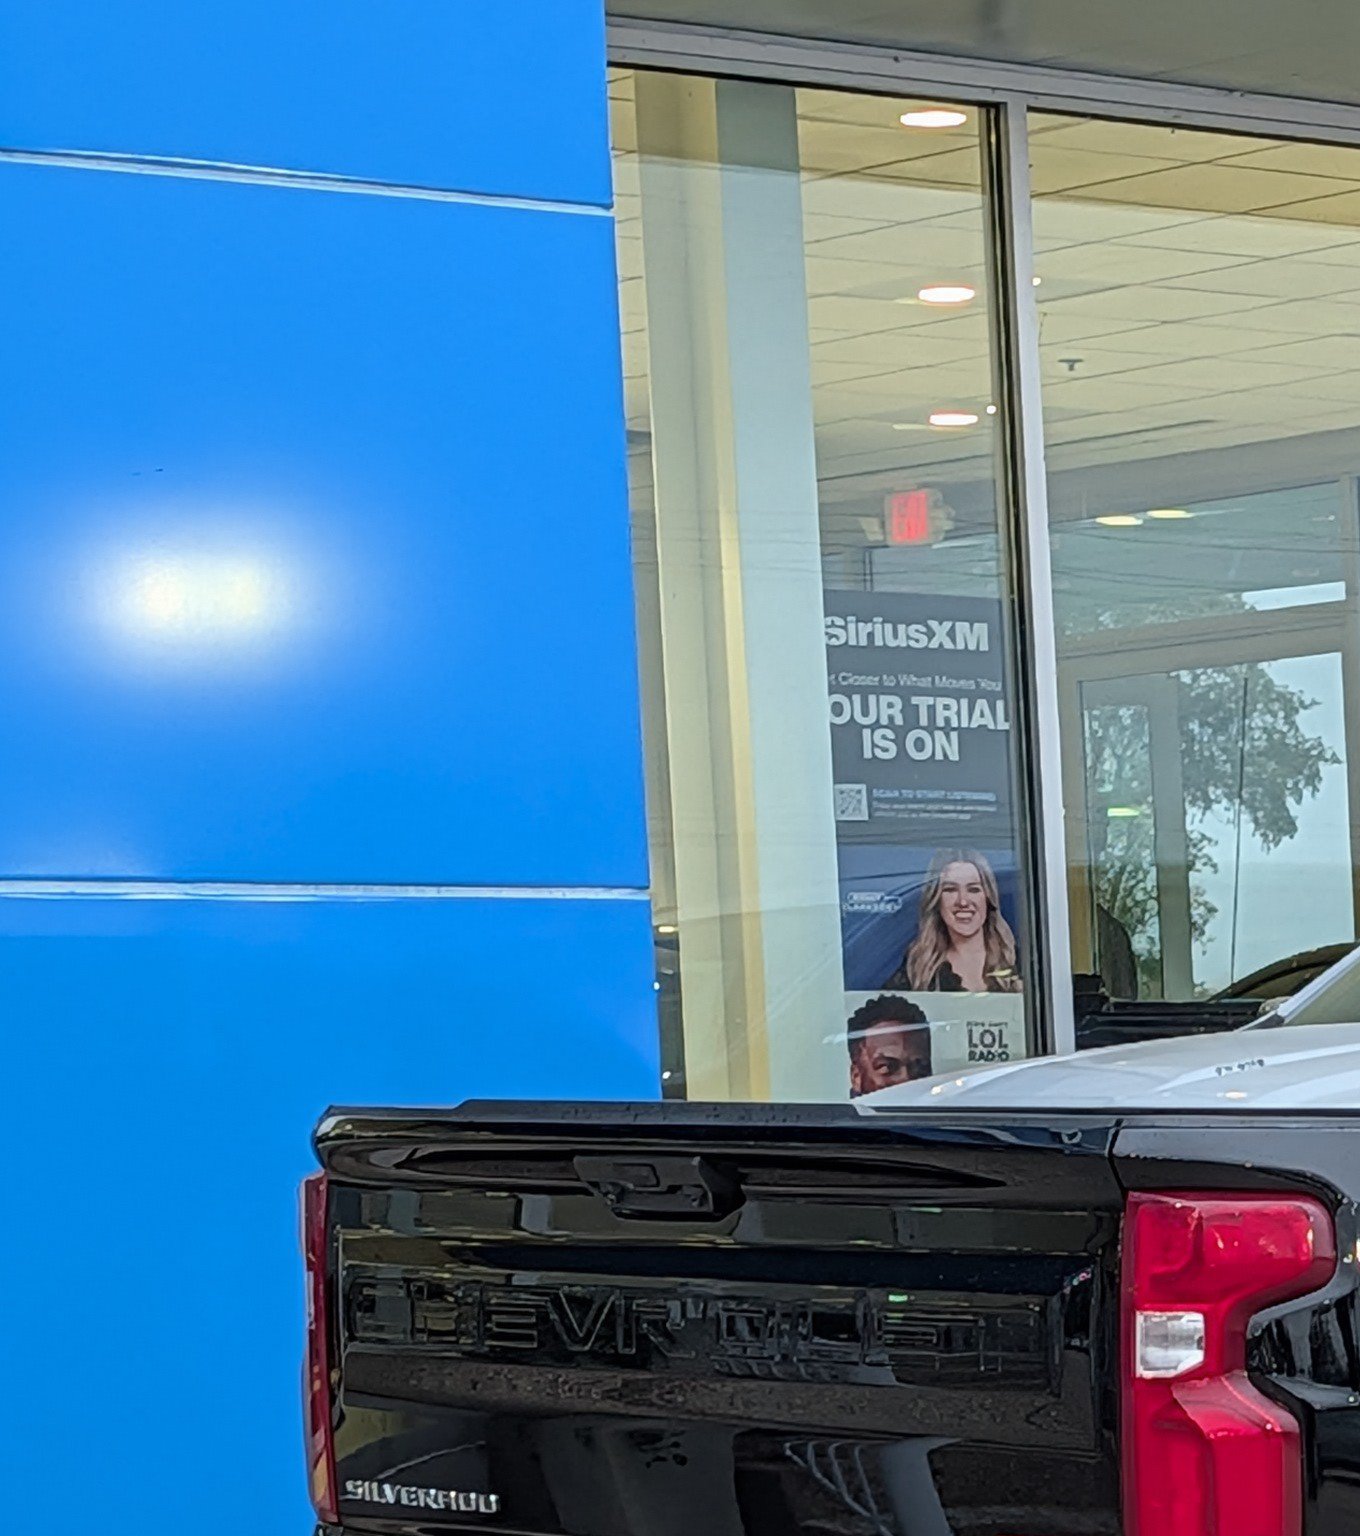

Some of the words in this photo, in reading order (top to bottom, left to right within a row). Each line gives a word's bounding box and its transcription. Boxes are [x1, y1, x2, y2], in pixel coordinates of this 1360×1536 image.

[824, 615, 989, 652] SiriusXM
[829, 693, 904, 727] OUR
[911, 696, 1011, 731] TRIAL
[862, 728, 898, 760] IS
[905, 729, 960, 762] ON
[967, 1028, 1009, 1049] LOL
[338, 1479, 500, 1514] SILVERADO
